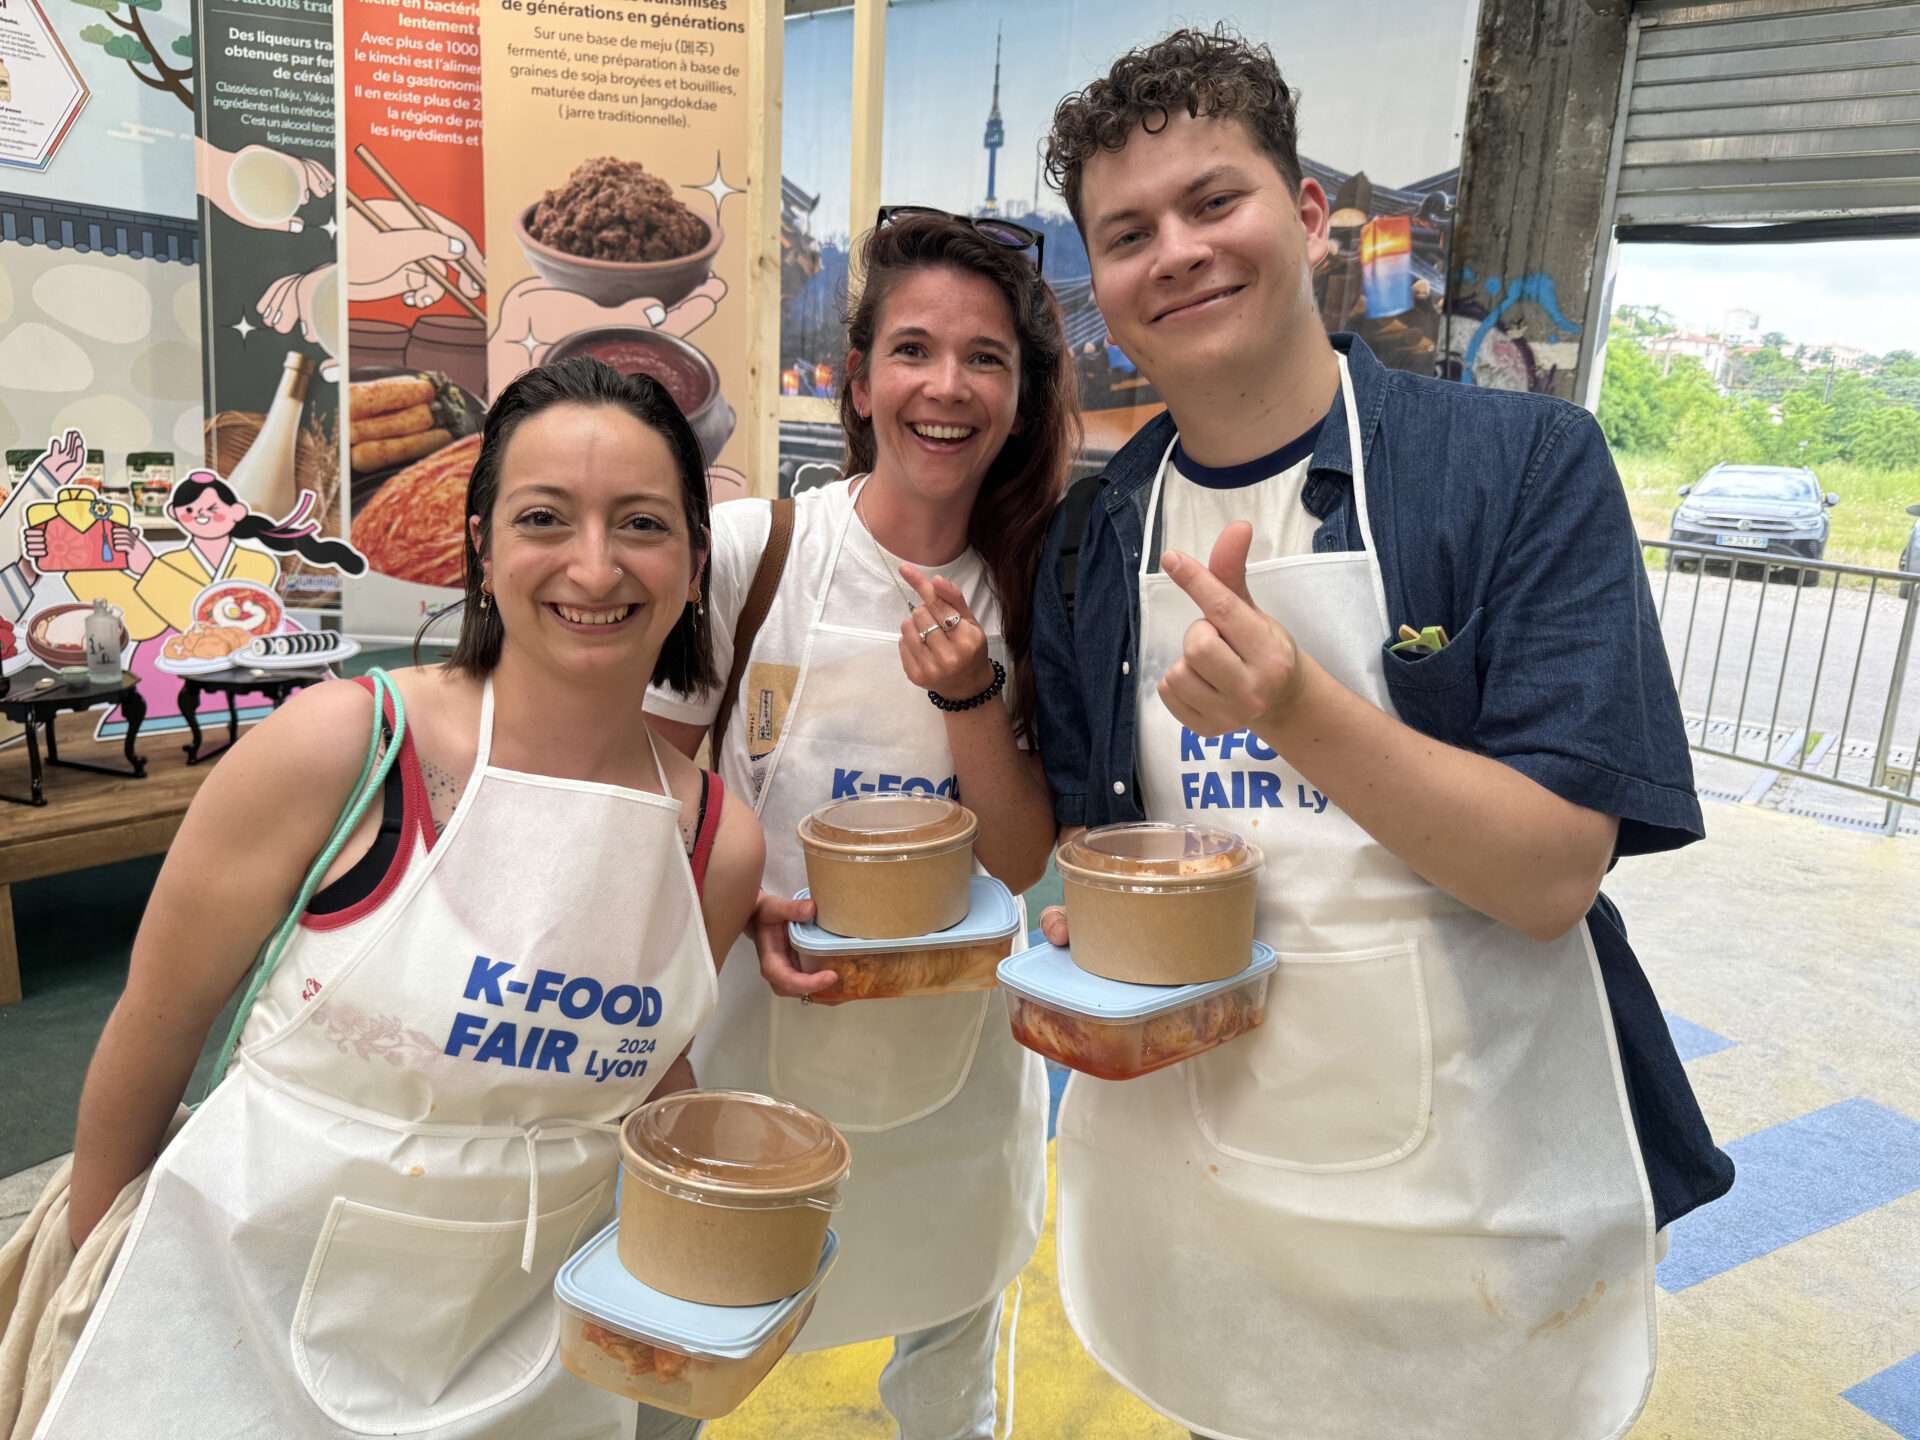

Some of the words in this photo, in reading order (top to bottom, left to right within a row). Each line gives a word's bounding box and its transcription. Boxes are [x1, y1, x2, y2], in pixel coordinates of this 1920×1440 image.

[399, 13, 475, 35] lentement
[502, 0, 522, 11] de
[526, 0, 624, 21] générations
[626, 12, 647, 23] en
[650, 12, 745, 33] générations
[229, 27, 254, 42] Des
[257, 30, 312, 48] liqueurs
[361, 31, 394, 46] Avec
[396, 36, 424, 50] plus
[425, 39, 443, 52] de
[446, 41, 479, 56] 1000
[534, 26, 556, 39] Sur
[559, 32, 584, 42] une
[587, 32, 617, 46] base
[620, 35, 637, 48] de
[640, 38, 672, 53] meju
[225, 45, 288, 63] obtenues
[291, 54, 314, 66] par
[354, 48, 366, 61] le
[368, 50, 411, 66] kimchi
[413, 57, 433, 69] est
[507, 43, 571, 62] fermenté,
[574, 52, 599, 63] une
[602, 53, 677, 70] préparation
[680, 59, 687, 71] à
[690, 61, 720, 75] base
[723, 64, 740, 76] de
[273, 67, 291, 80] de
[372, 69, 391, 82] de
[393, 71, 404, 84] la
[510, 64, 558, 78] graines
[561, 67, 578, 80] de
[581, 70, 607, 85] soja
[610, 72, 662, 88] broyées
[664, 79, 677, 89] et
[680, 78, 736, 96] bouillies,
[216, 81, 258, 96] Classées
[260, 88, 272, 98] en
[273, 87, 302, 102] Takju,
[354, 85, 362, 97] Il
[364, 89, 381, 99] en
[383, 90, 421, 104] existe
[423, 93, 451, 107] plus
[453, 97, 470, 109] de
[531, 86, 585, 100] maturée
[587, 89, 619, 103] dans
[622, 94, 638, 104] un
[641, 93, 718, 111] jangdokdae
[213, 96, 269, 112] ingrédients
[270, 103, 280, 113] et
[281, 104, 290, 114] la
[267, 118, 280, 128] un
[280, 119, 311, 131] alcool
[387, 107, 399, 119] la
[401, 110, 443, 125] région
[445, 114, 463, 126] de
[266, 131, 280, 143] les
[281, 133, 313, 146] jeunes
[370, 123, 389, 136] les
[391, 125, 464, 145] ingrédients
[1181, 771, 1284, 810] FAIR
[462, 955, 663, 1028] K-FOOD
[443, 1012, 579, 1073] FAIR
[584, 1050, 648, 1082] Lyon
[616, 1037, 656, 1054] 2024
